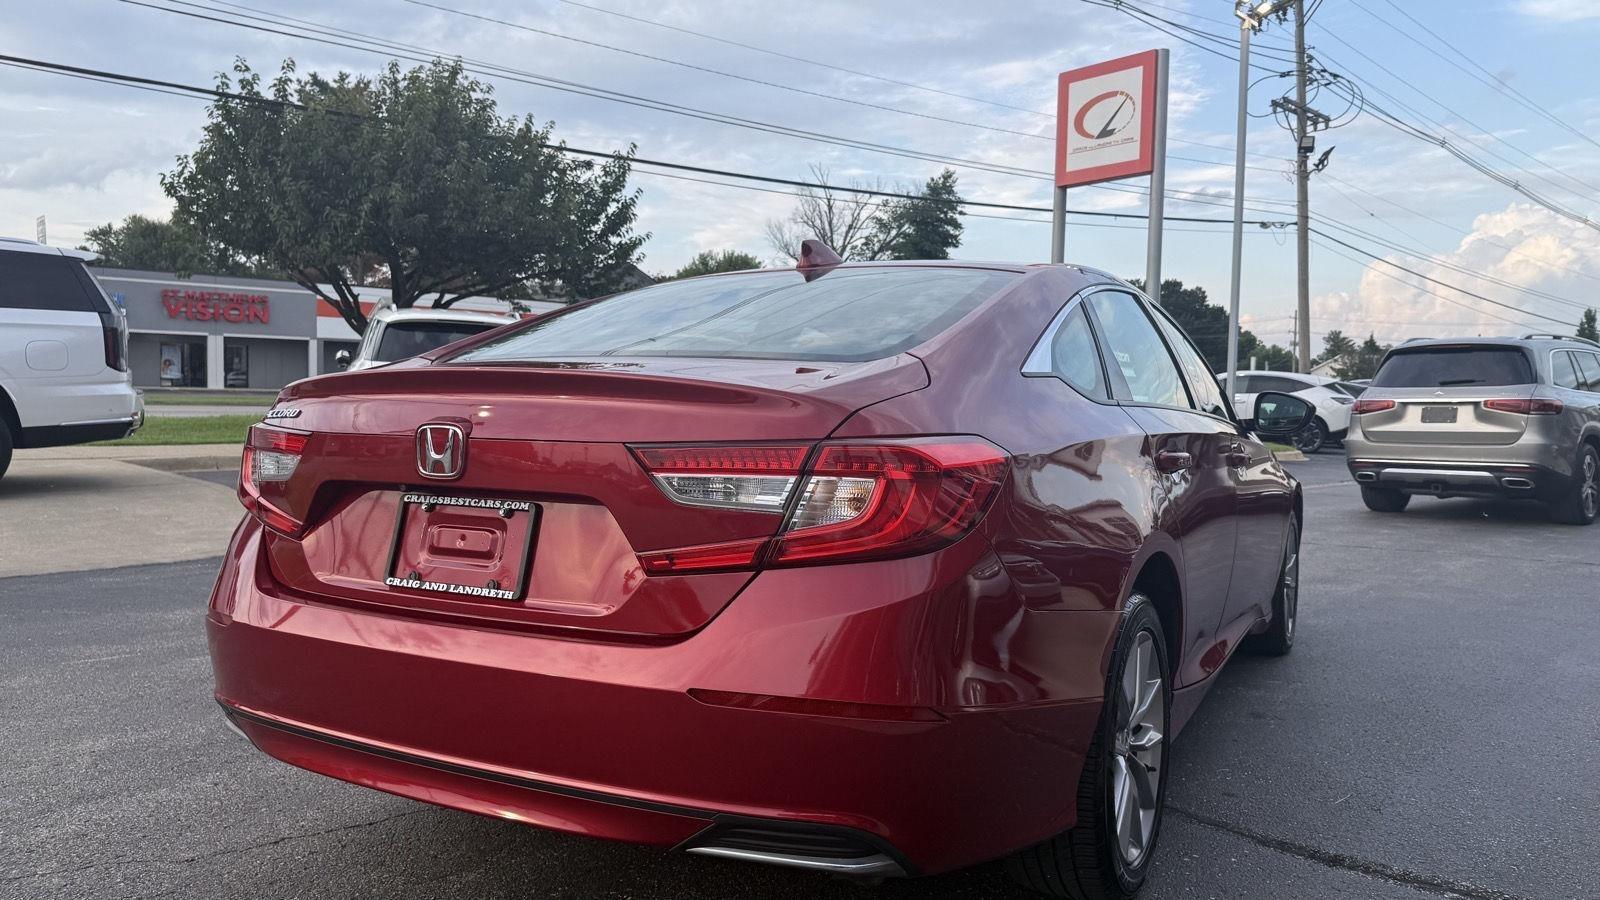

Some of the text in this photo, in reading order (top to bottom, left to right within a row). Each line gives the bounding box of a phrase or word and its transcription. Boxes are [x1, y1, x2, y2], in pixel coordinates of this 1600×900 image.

[184, 290, 269, 304] MATTHEWS
[161, 301, 270, 324] VISION
[403, 495, 530, 510] CRAIGSBESTCARS.COM
[385, 577, 515, 600] CRAIG AND LANDRETH
